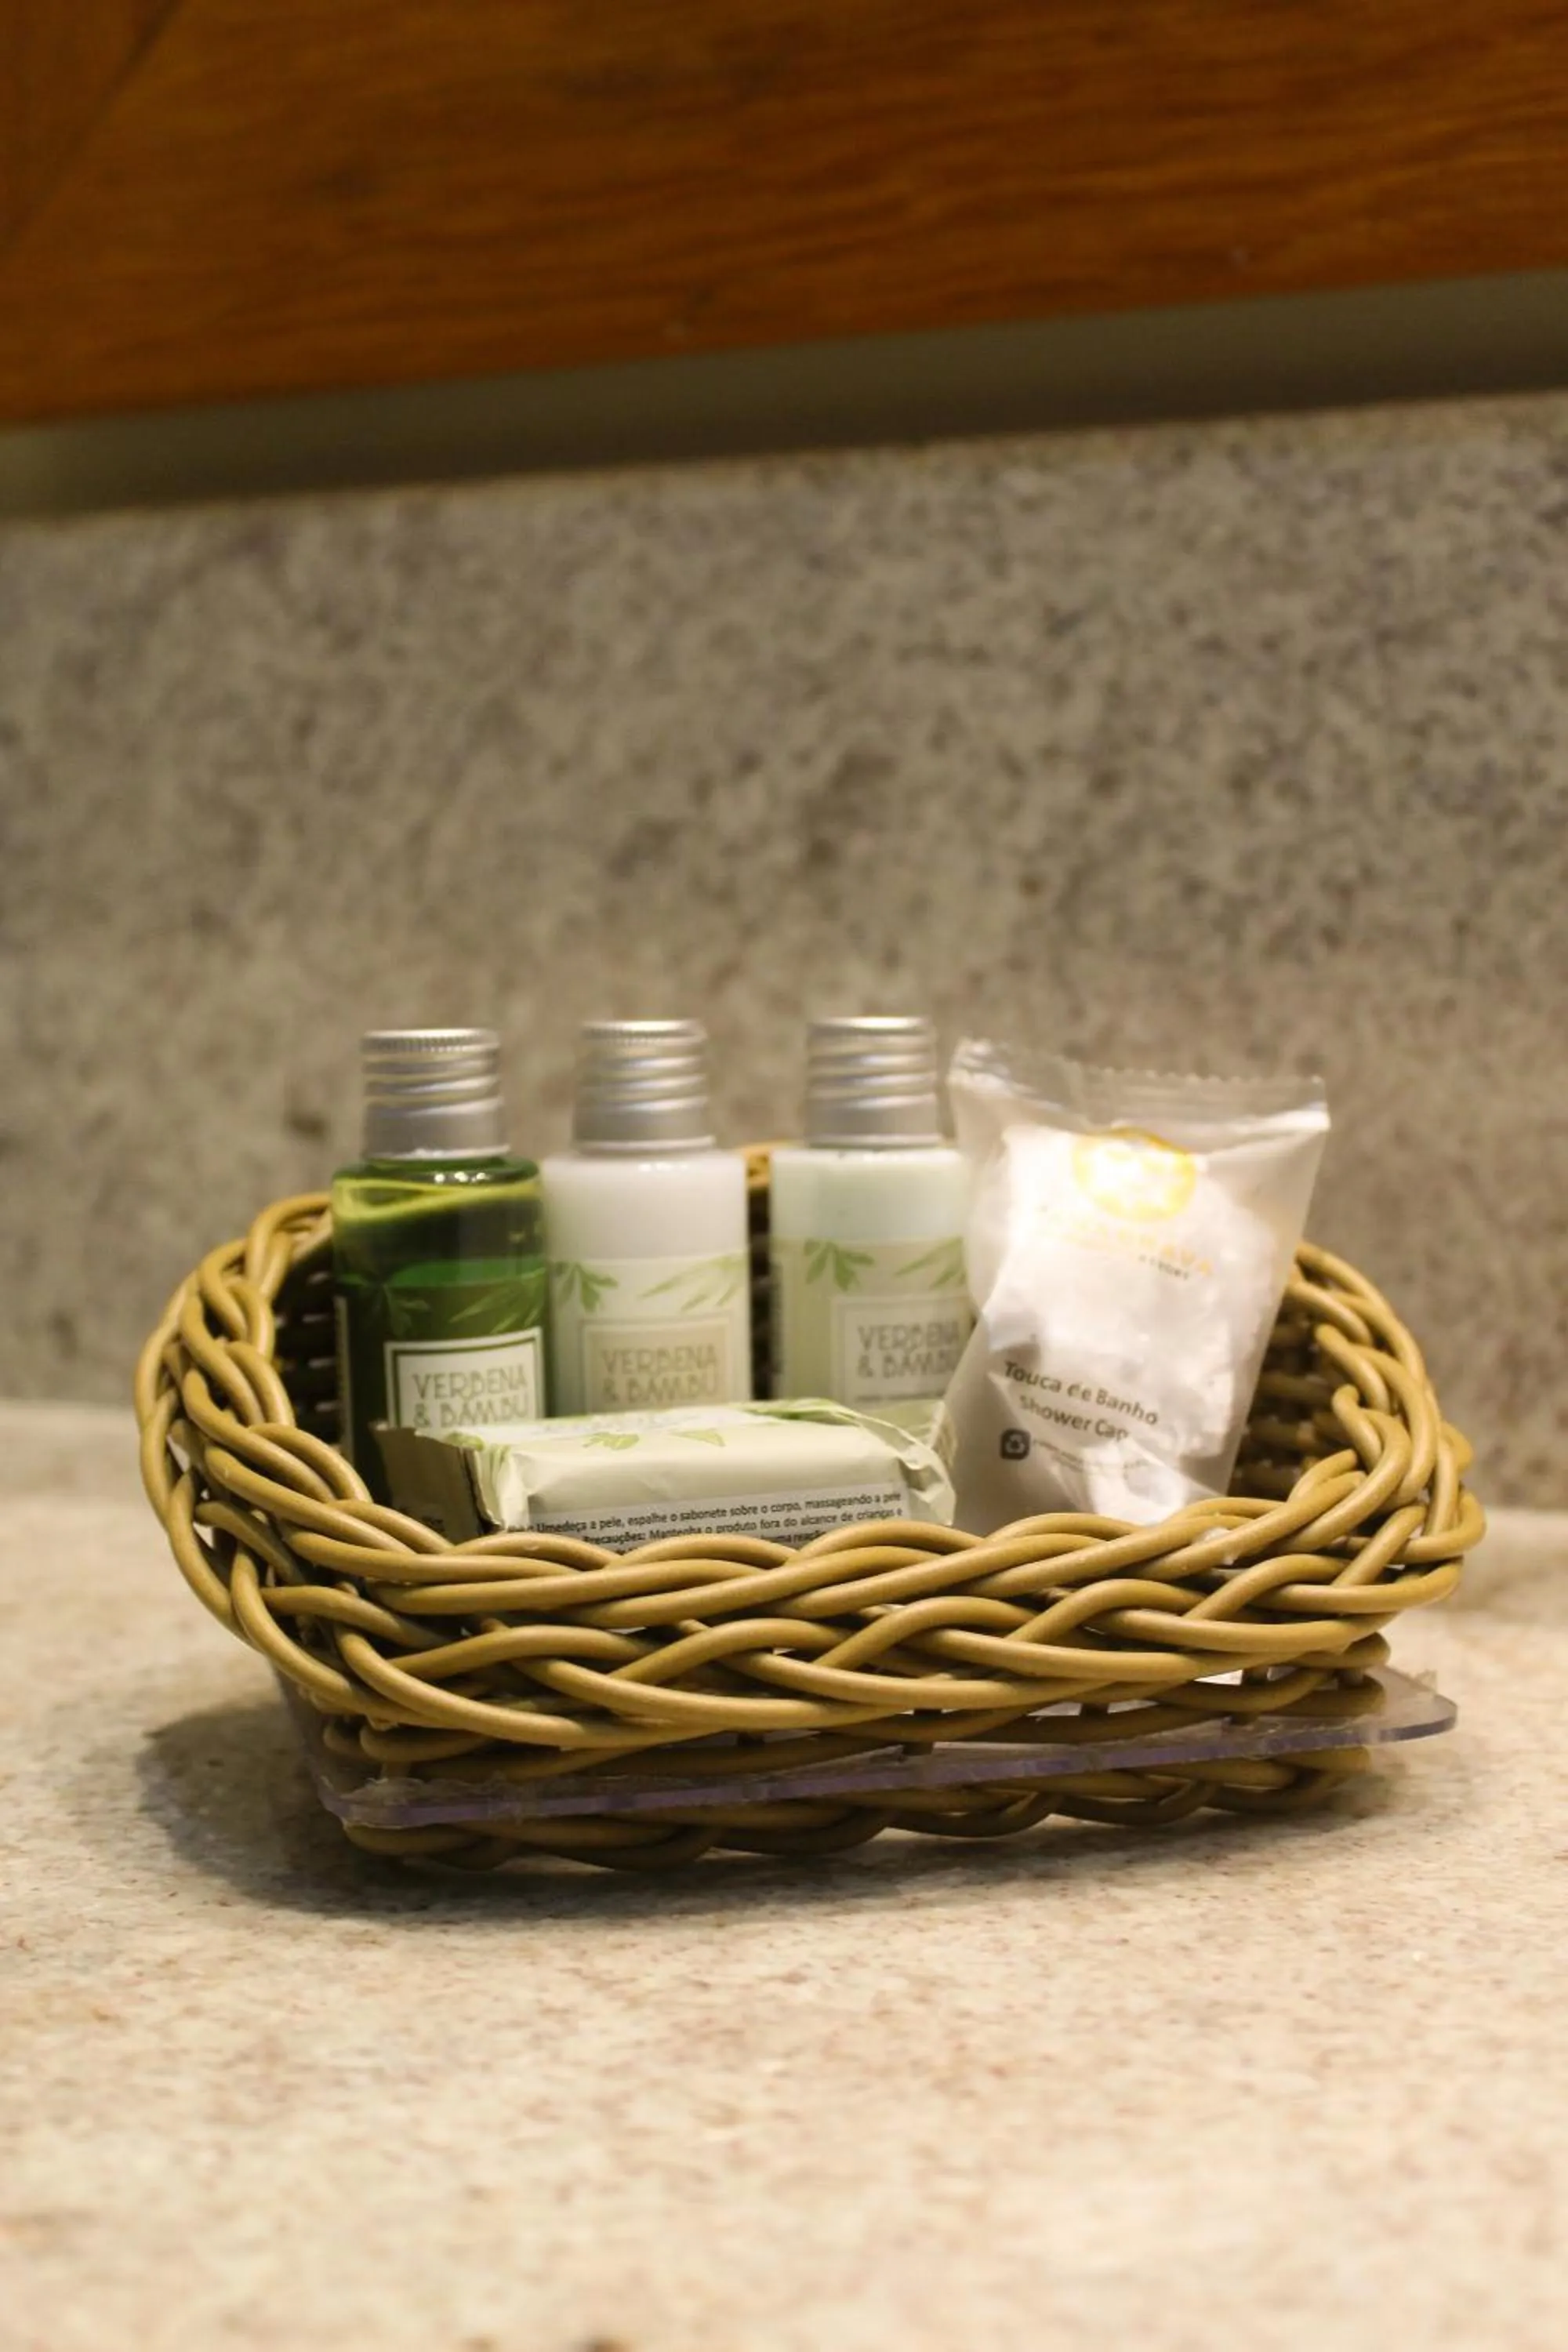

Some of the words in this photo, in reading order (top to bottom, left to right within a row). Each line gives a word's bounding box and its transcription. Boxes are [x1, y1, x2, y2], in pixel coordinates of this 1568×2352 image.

[601, 1344, 717, 1376] VERBENA
[412, 1363, 528, 1400] VERBENA
[602, 1377, 621, 1403] &
[628, 1373, 717, 1404] BAMBU
[1004, 1360, 1062, 1393] Touca
[1067, 1382, 1093, 1401] de
[1096, 1389, 1159, 1425] Banho
[413, 1403, 433, 1428] &
[441, 1392, 528, 1428] BAMBU
[1020, 1395, 1091, 1431] Shower
[1094, 1419, 1128, 1441] Cap
[599, 1515, 625, 1530] pele,
[627, 1512, 666, 1526] espalhe
[670, 1513, 677, 1522] o
[680, 1508, 728, 1521] sabonete
[730, 1503, 758, 1517] sobre
[760, 1504, 768, 1514] o
[771, 1502, 802, 1513] corpo,
[805, 1494, 873, 1509] massageando
[883, 1493, 901, 1504] pele
[716, 1521, 757, 1534] produto
[760, 1519, 780, 1530] fora
[783, 1518, 798, 1527] do
[800, 1514, 837, 1526] alcance
[840, 1512, 853, 1522] de
